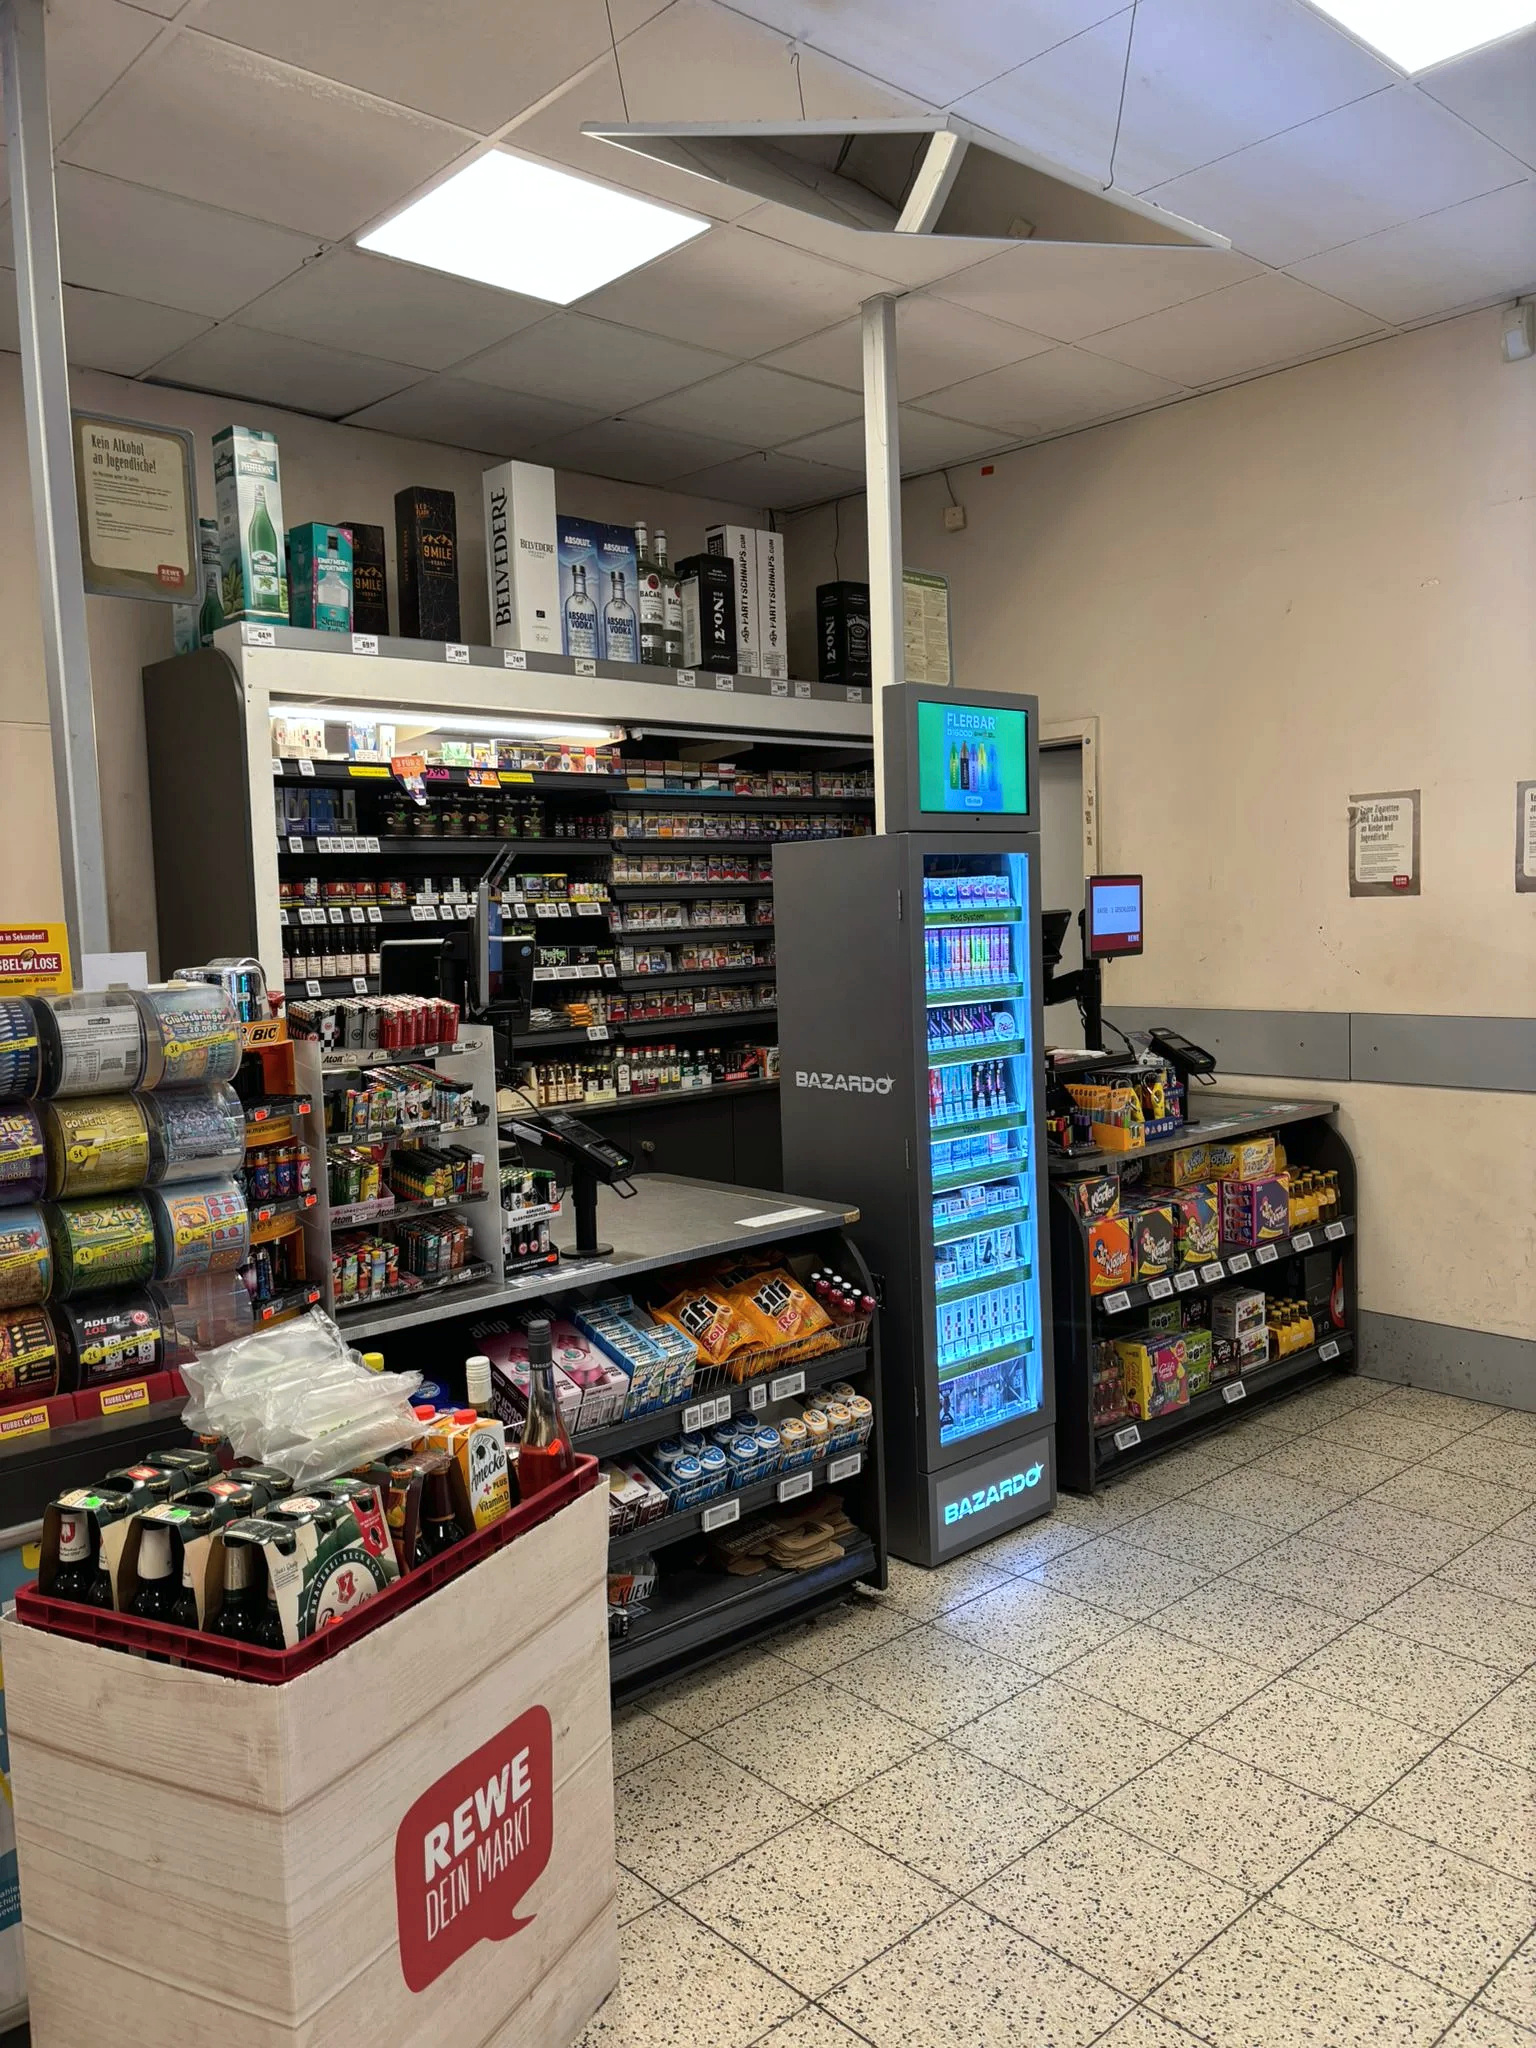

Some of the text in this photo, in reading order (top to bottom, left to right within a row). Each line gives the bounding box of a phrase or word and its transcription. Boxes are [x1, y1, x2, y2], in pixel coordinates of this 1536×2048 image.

[91, 434, 144, 457] Kein Alkohol
[92, 452, 157, 474] an Jugendliche!
[423, 546, 452, 560] 9 MILE
[520, 538, 555, 554] BELVEDERE
[490, 487, 512, 630] BELVEDERE
[362, 579, 382, 592] MILE
[740, 534, 750, 627] PARTYSCHNAPS.COM
[768, 539, 778, 631] PARTYSCHNAPS.COM
[568, 611, 595, 622] ABSOLUT
[607, 616, 633, 627] ABSOLUT
[571, 620, 593, 630] VODKA
[609, 625, 632, 635] VODKA
[947, 712, 996, 730] FLERBAR
[1374, 804, 1400, 815] Zigaretten
[1371, 814, 1399, 823] Tabakwaren
[1368, 824, 1383, 832] Kinder
[1384, 822, 1394, 831] und
[1360, 832, 1390, 844] Jugendliche!
[951, 913, 985, 923] Pod System
[5, 933, 12, 941] in
[12, 931, 45, 941] Sekunden!
[34, 957, 59, 970] LOSE
[165, 1012, 227, 1025] Glücksbringer
[251, 1026, 278, 1041] BIC
[795, 1071, 897, 1095] BAZARDO
[65, 1117, 108, 1129] GOLDENE
[73, 1148, 83, 1159] 5€
[1091, 1185, 1116, 1211] Klopfer
[80, 1251, 89, 1260] 2€
[1105, 1252, 1129, 1275] Klopfer
[84, 1315, 120, 1329] ADLER
[85, 1325, 107, 1336] LOS
[701, 1322, 727, 1352] Roll
[87, 1351, 98, 1361] 2€
[105, 1389, 144, 1405] RUBBEL LOSE
[2, 1413, 45, 1432] RUBBEL LOSE
[492, 1477, 507, 1489] PLUS
[944, 1461, 1045, 1526] BAZARDO
[478, 1490, 509, 1513] Vitamin D
[310, 1558, 339, 1614] BRAUEREI
[342, 1551, 365, 1562] BECK
[423, 1746, 533, 1884] REWE
[425, 1797, 533, 1943] DEIN MARKT
